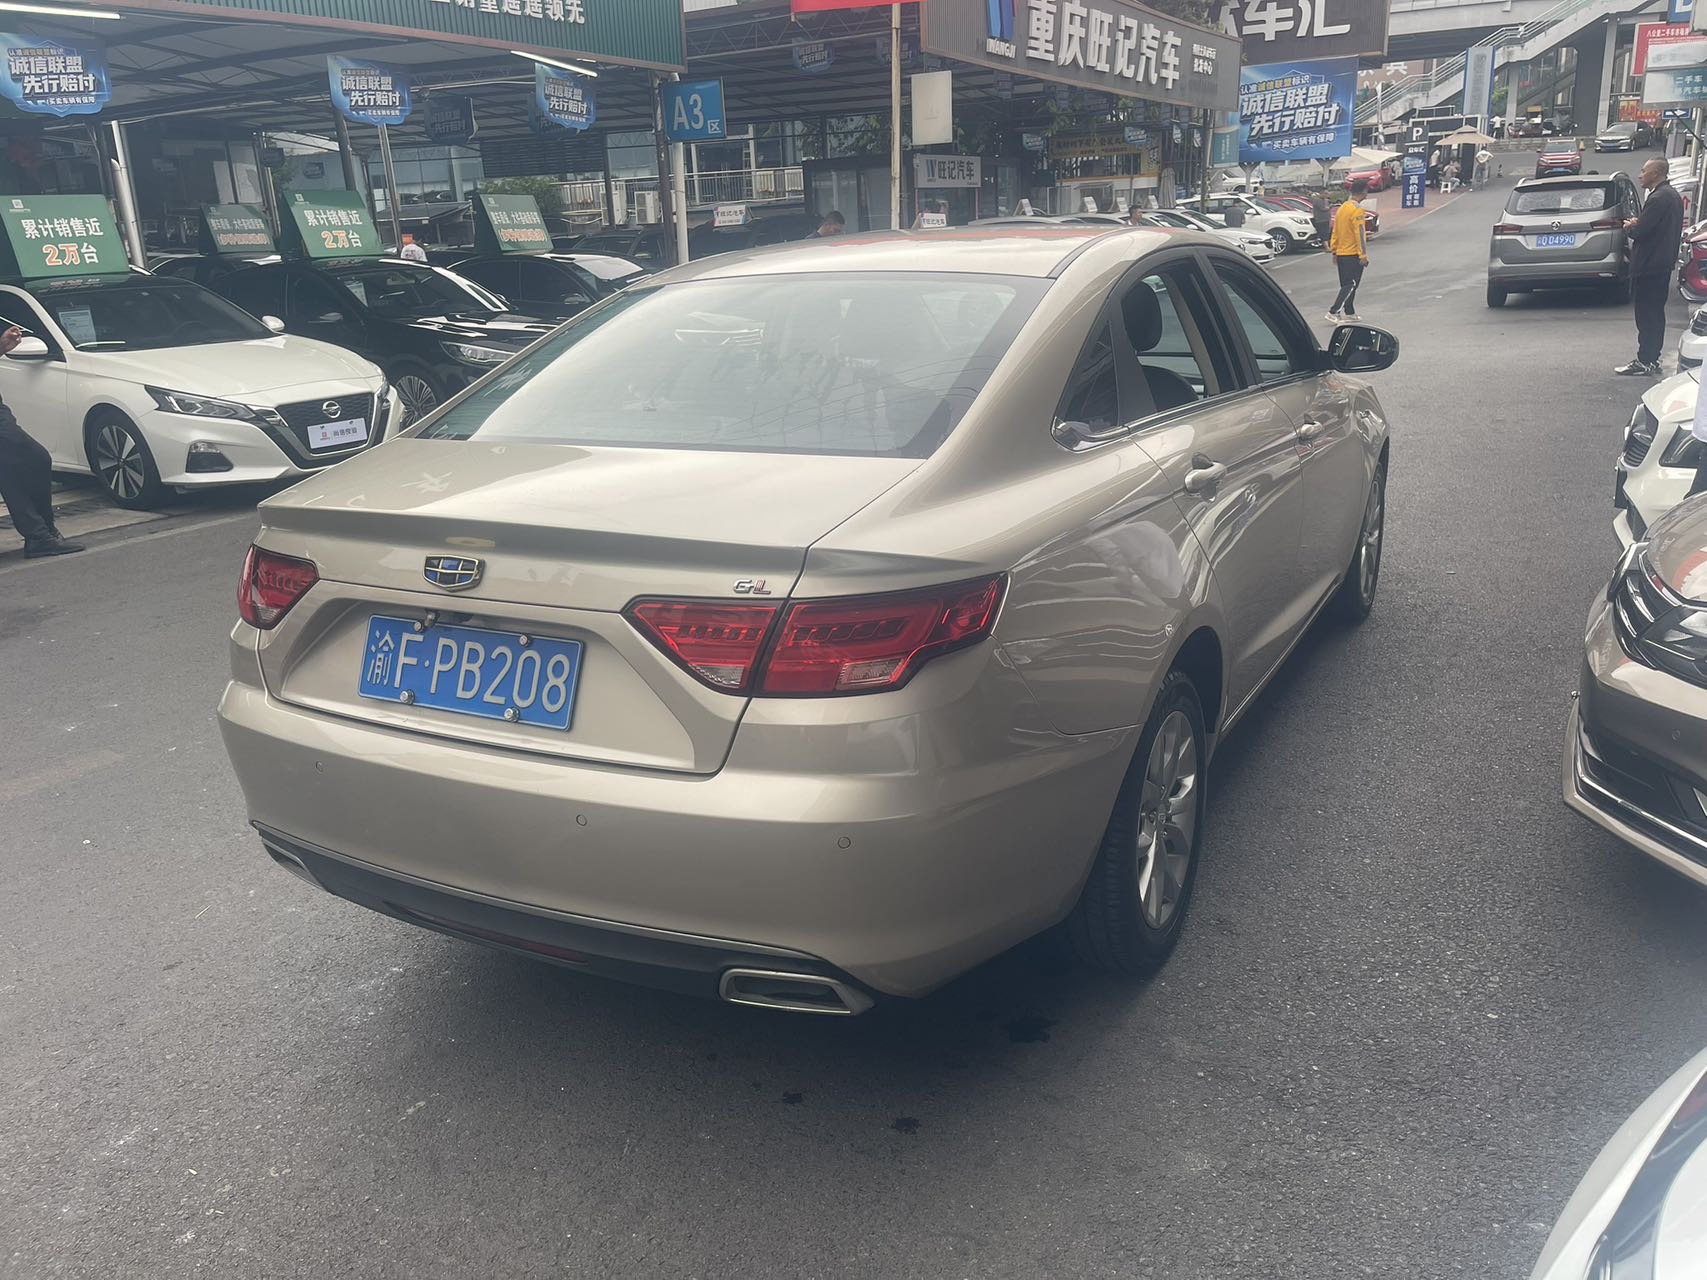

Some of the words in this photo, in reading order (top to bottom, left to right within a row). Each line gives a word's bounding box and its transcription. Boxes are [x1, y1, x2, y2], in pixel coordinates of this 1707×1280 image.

[432, 0, 585, 24] 量遥遥领先
[1026, 0, 1181, 89] 重庆旺记汽车
[9, 56, 83, 74] 诚信联盟
[24, 73, 95, 93] 先行赔付
[341, 76, 392, 90] 诚信联盟
[1240, 74, 1311, 95] 认准诚信联盟标识
[1676, 75, 1703, 84] 二手车
[351, 91, 400, 106] 先行赔付
[545, 84, 582, 101] 诚信联盟
[1241, 83, 1330, 116] 诚信联盟
[550, 97, 588, 114] 先行赔付
[1250, 104, 1340, 136] 先行赔付
[1273, 132, 1334, 150] 买卖车辆有保障
[1412, 127, 1423, 141] P
[937, 160, 975, 180] 旺记汽车
[304, 210, 363, 226] 累计销售近
[21, 218, 104, 239] 累计销售近
[321, 230, 363, 248] 2万台
[42, 242, 99, 266] 2万台
[732, 578, 771, 595] GL
